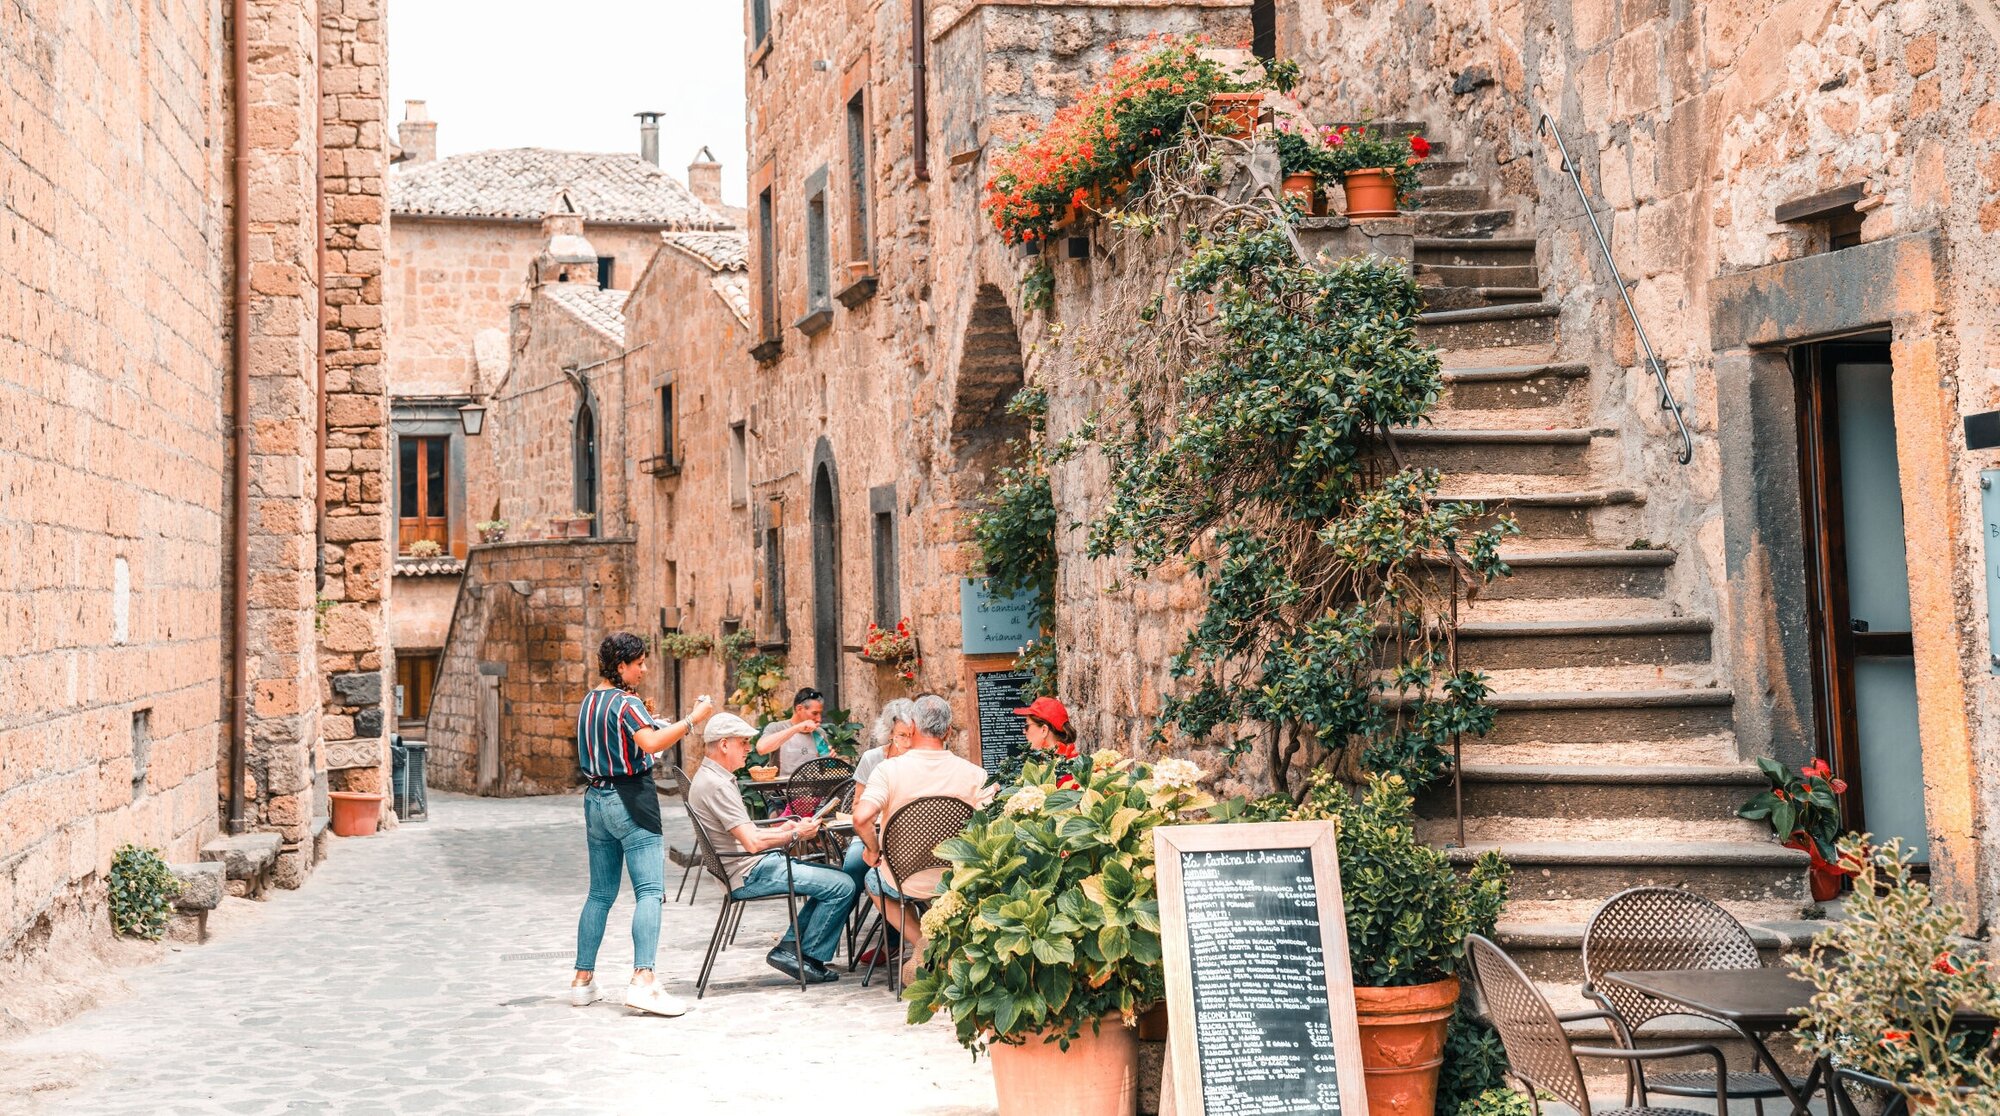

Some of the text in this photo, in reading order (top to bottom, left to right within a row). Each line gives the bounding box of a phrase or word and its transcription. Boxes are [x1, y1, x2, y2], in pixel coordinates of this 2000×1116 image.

[991, 603, 1026, 613] cantina
[1011, 615, 1021, 625] di
[984, 632, 1023, 642] Arianna
[1203, 852, 1244, 867] Cantina
[1245, 850, 1256, 865] di
[1199, 1011, 1228, 1020] SECONDI
